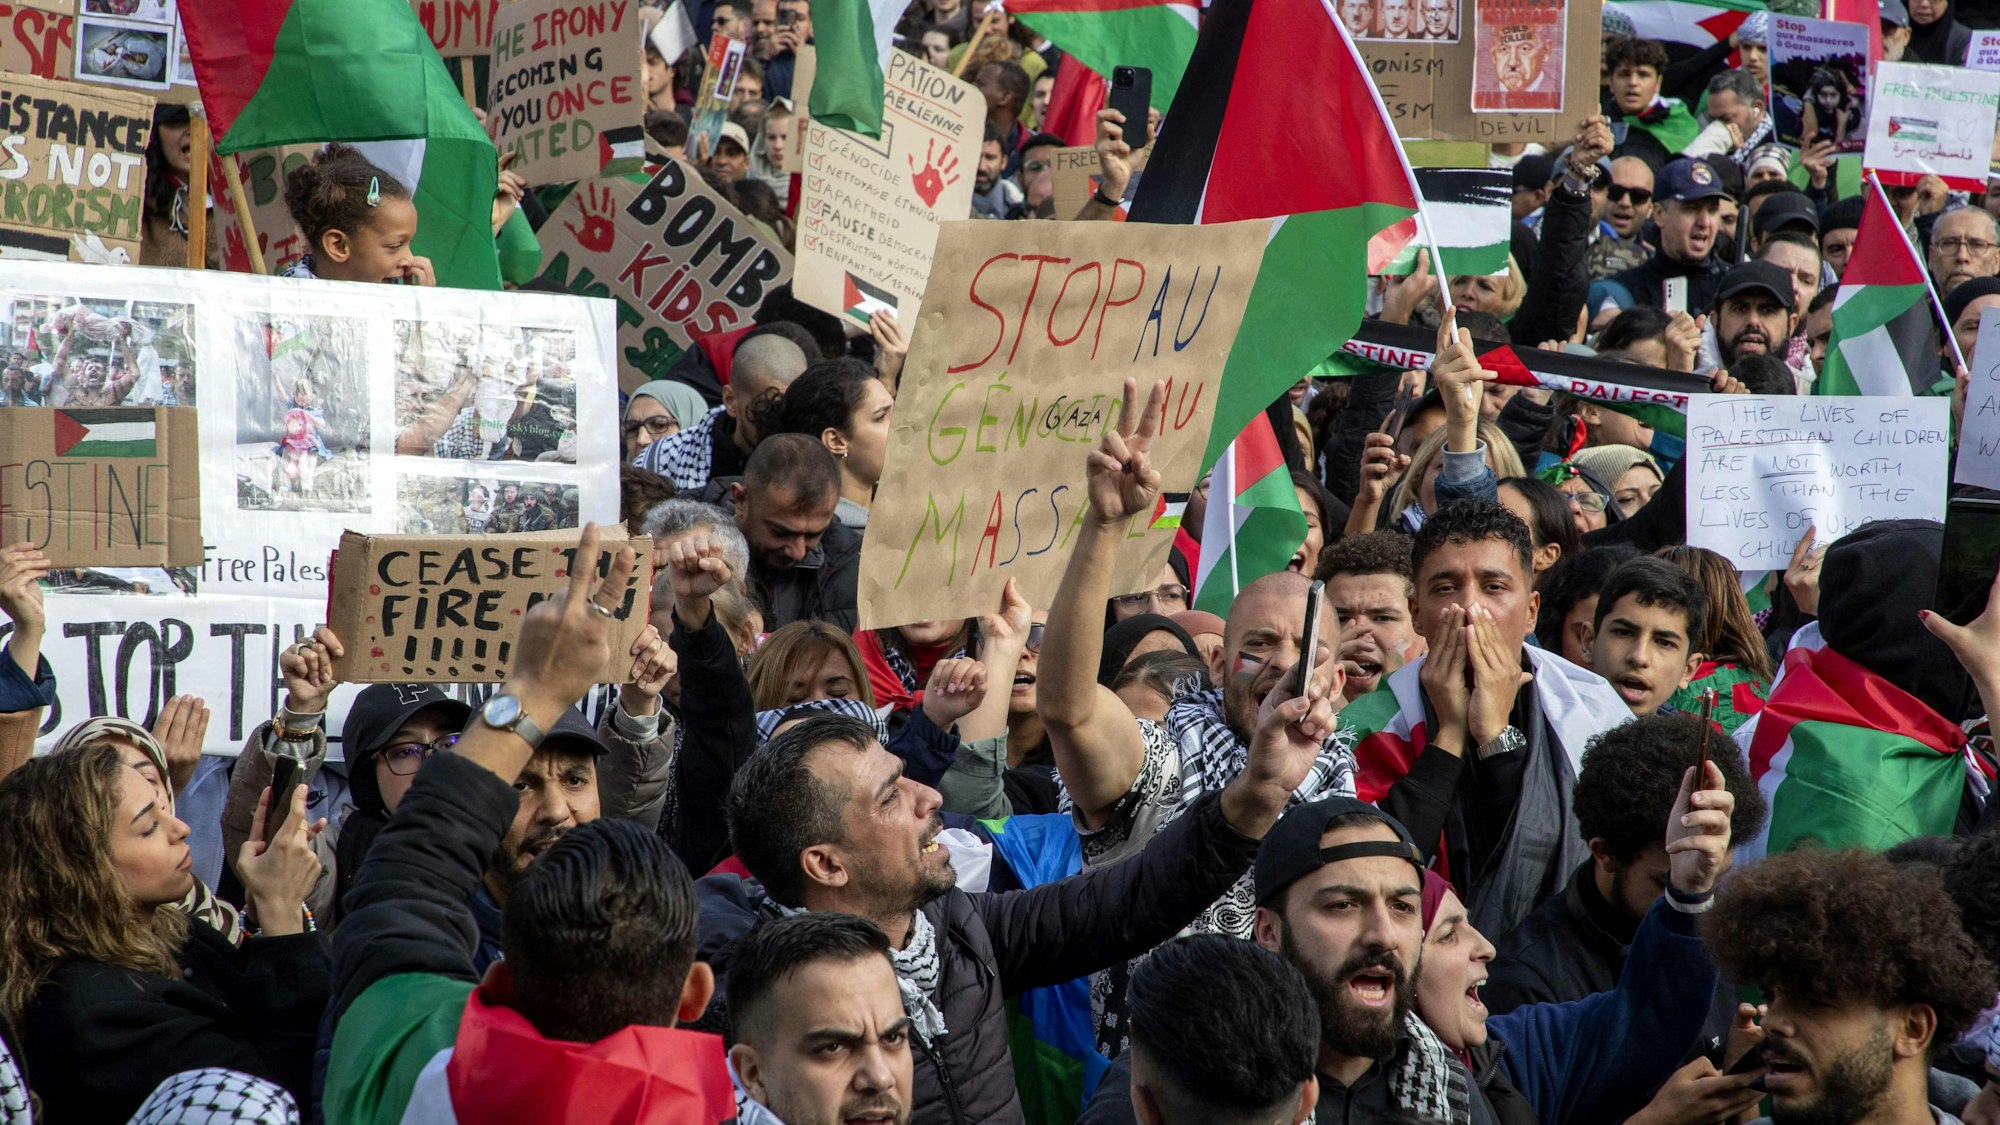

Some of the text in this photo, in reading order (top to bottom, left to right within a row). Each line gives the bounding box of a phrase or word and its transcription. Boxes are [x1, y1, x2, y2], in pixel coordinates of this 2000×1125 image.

[493, 0, 627, 69] HE IRONY
[1776, 19, 1807, 33] Stop
[1776, 31, 1855, 47] aux massacres
[1784, 41, 1811, 52] Gaza
[501, 98, 541, 137] YOU
[546, 75, 632, 121] ONCE
[1883, 82, 2000, 107] FREE PALESTINE
[47, 143, 142, 190] NOT
[1057, 150, 1098, 172] FREE
[0, 180, 140, 239] RORiSM
[821, 203, 875, 240] FAUSSE
[625, 158, 782, 309] BOMB
[947, 253, 1221, 374] STOP AU
[1045, 395, 1100, 430] GAZA
[1708, 398, 1776, 424] THE
[1879, 409, 1910, 424] OF
[1701, 451, 1902, 478] ARE NOT WORTH
[1700, 480, 1915, 502] LESS THAN THE
[1785, 508, 1817, 529] OF
[202, 546, 256, 583] Free
[377, 547, 542, 588] CEASE
